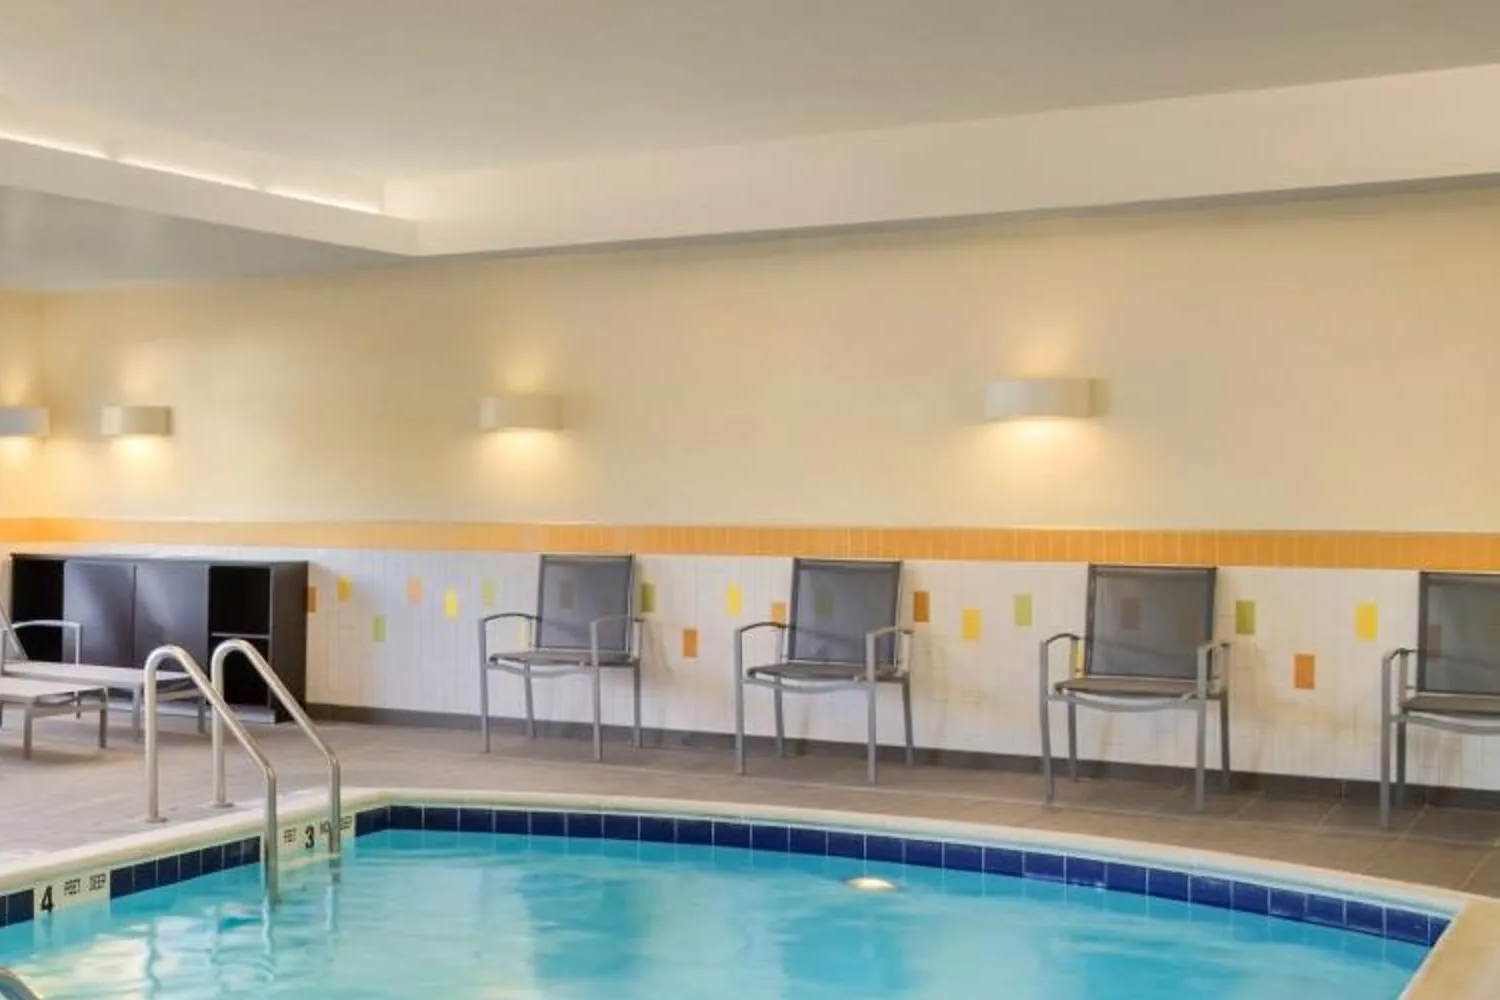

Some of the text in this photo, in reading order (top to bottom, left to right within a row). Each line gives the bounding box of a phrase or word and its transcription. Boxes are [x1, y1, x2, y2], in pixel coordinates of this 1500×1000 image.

[305, 825, 315, 849] 3
[41, 873, 106, 912] 4 FEET DEEP
